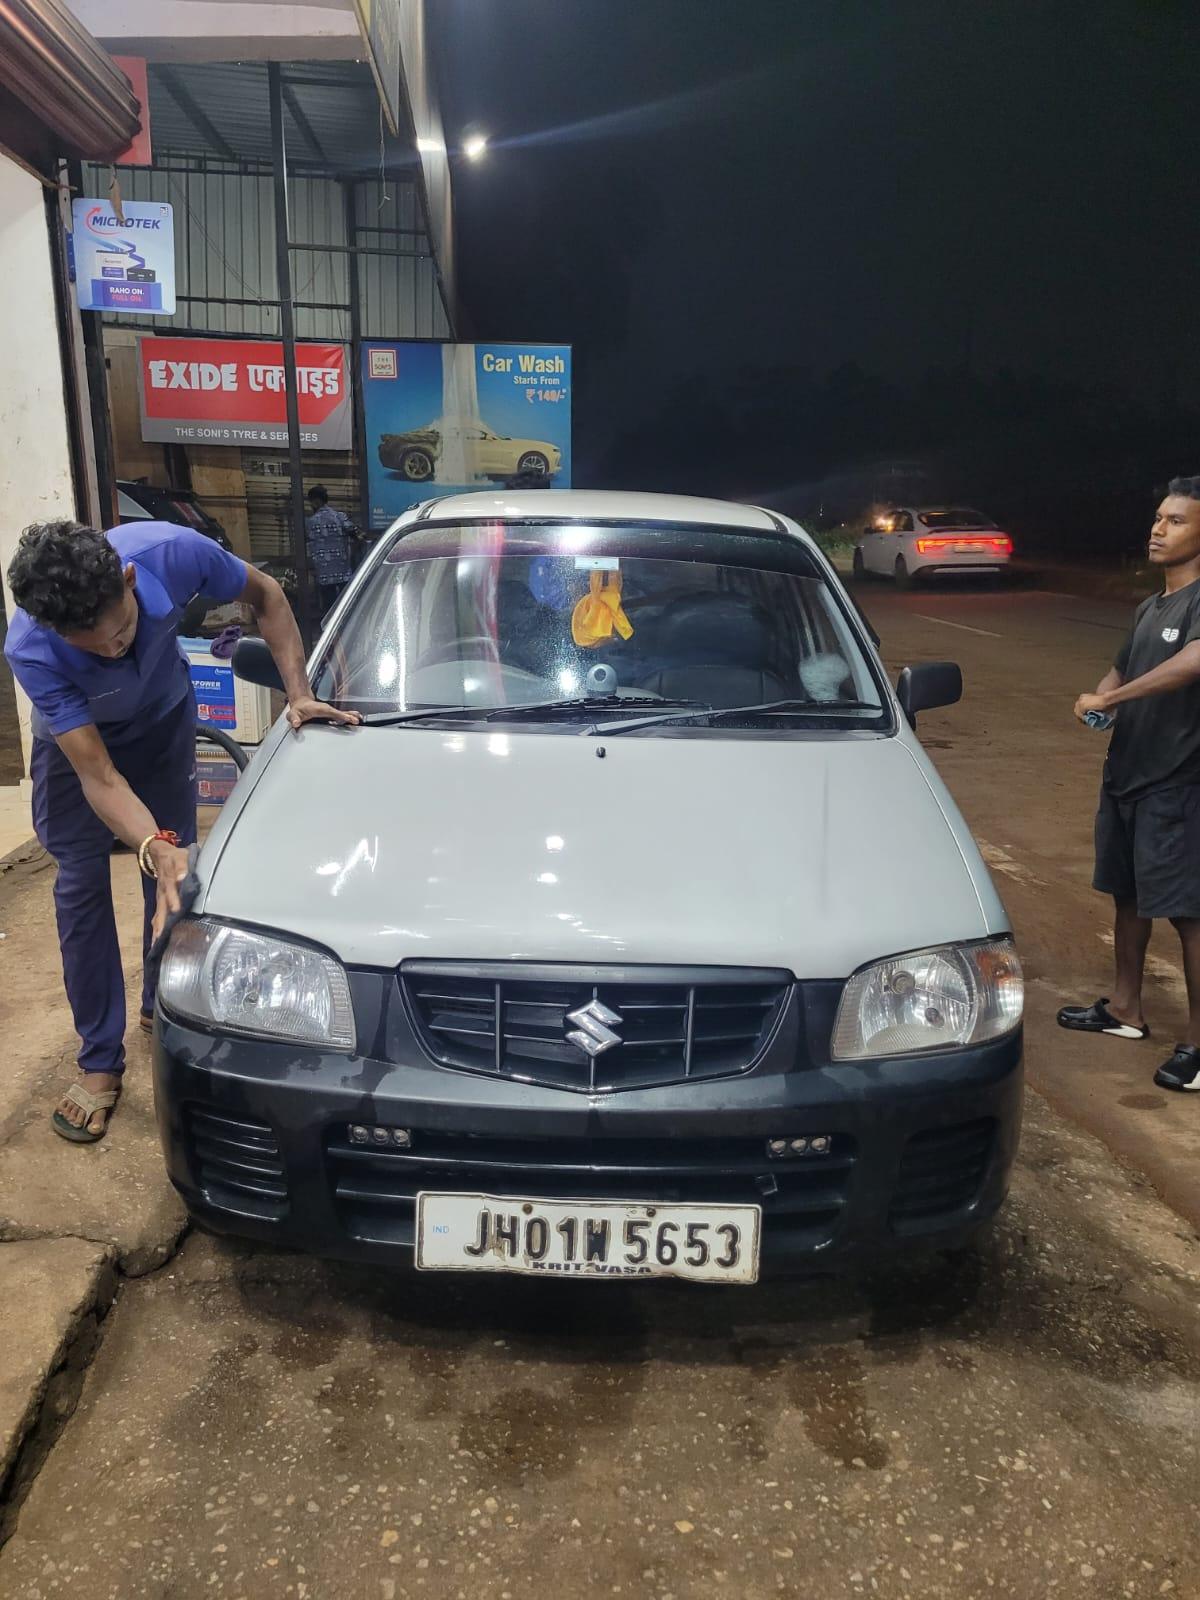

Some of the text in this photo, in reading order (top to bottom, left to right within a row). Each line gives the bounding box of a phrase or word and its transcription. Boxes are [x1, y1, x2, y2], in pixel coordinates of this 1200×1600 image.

[92, 215, 160, 230] MICROTEK
[109, 287, 130, 295] RAHO
[482, 353, 565, 373] Car Wash
[148, 359, 239, 392] EXIDE
[513, 375, 560, 385] Starts From
[175, 427, 319, 442] THE SONI'S TYRE & SERCES
[432, 1225, 450, 1234] IND
[624, 1219, 741, 1268] 5653
